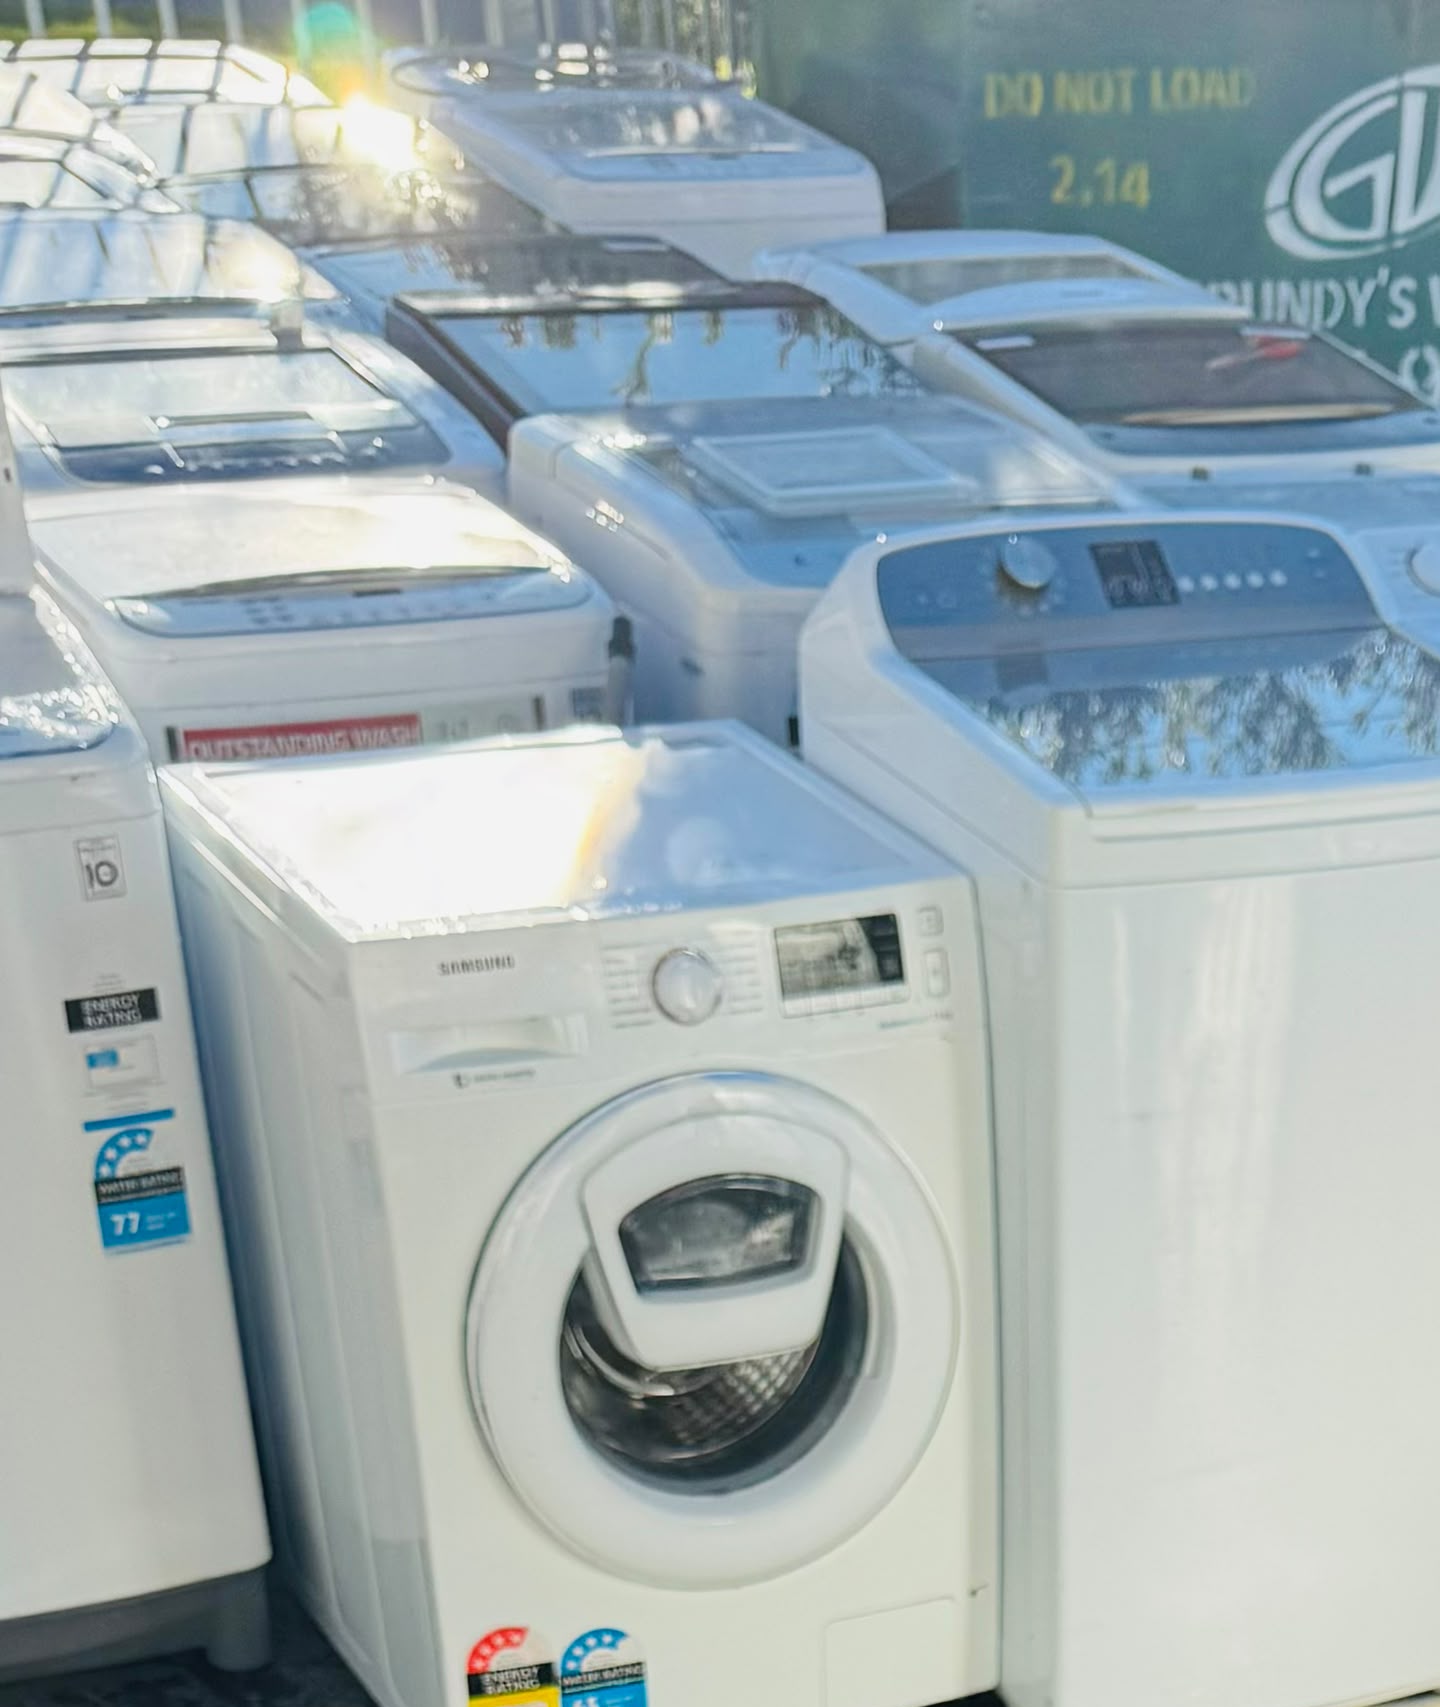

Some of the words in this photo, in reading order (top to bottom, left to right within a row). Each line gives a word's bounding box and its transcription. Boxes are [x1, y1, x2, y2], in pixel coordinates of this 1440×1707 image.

[984, 71, 1044, 119] DO
[1054, 68, 1137, 114] NOT
[1151, 66, 1256, 112] LOAD
